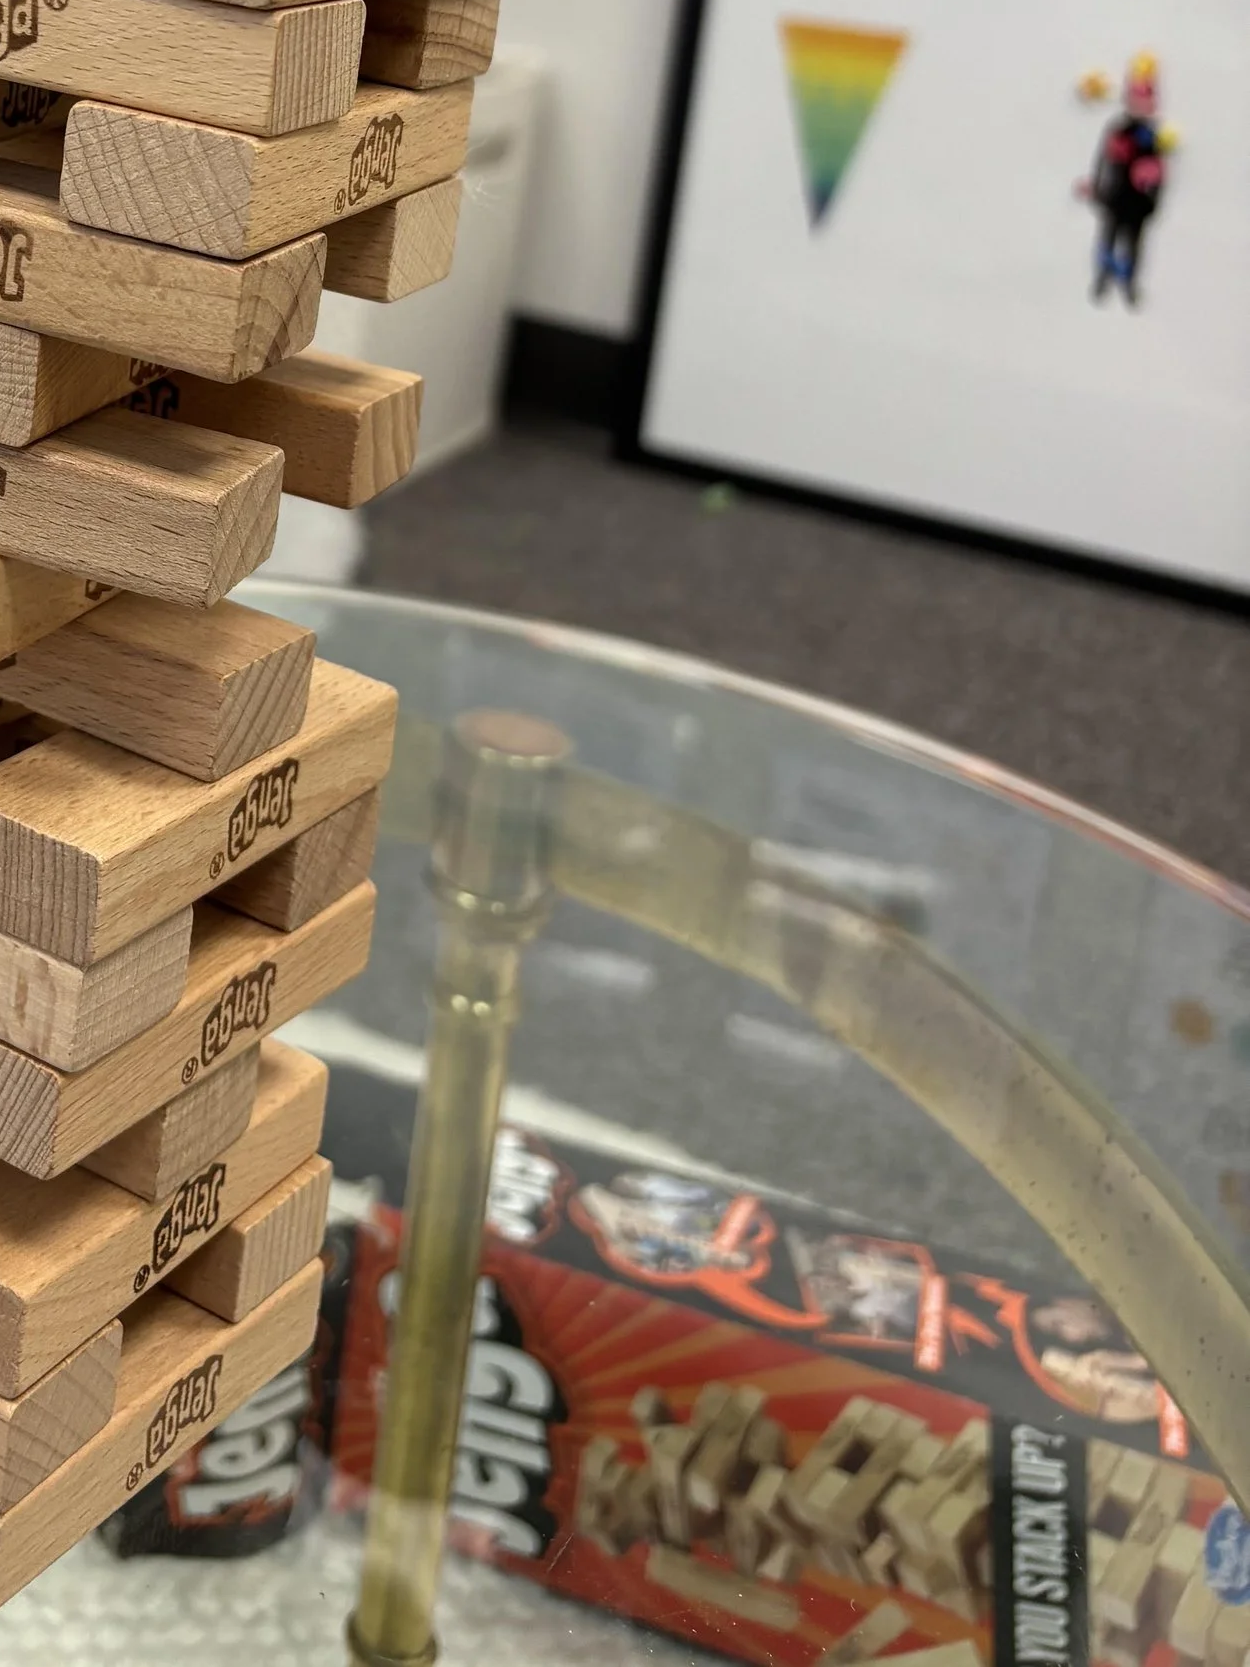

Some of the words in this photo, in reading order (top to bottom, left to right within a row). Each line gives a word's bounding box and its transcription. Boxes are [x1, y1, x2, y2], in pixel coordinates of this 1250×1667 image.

[349, 113, 406, 206] Jenga
[228, 758, 300, 860] Jenga
[201, 961, 277, 1066] Jenga
[152, 1163, 226, 1269] Jenga
[146, 1354, 223, 1469] Jenga
[1010, 1423, 1069, 1495] UP?
[1011, 1495, 1071, 1602] STACK
[1013, 1598, 1072, 1663] YOU
